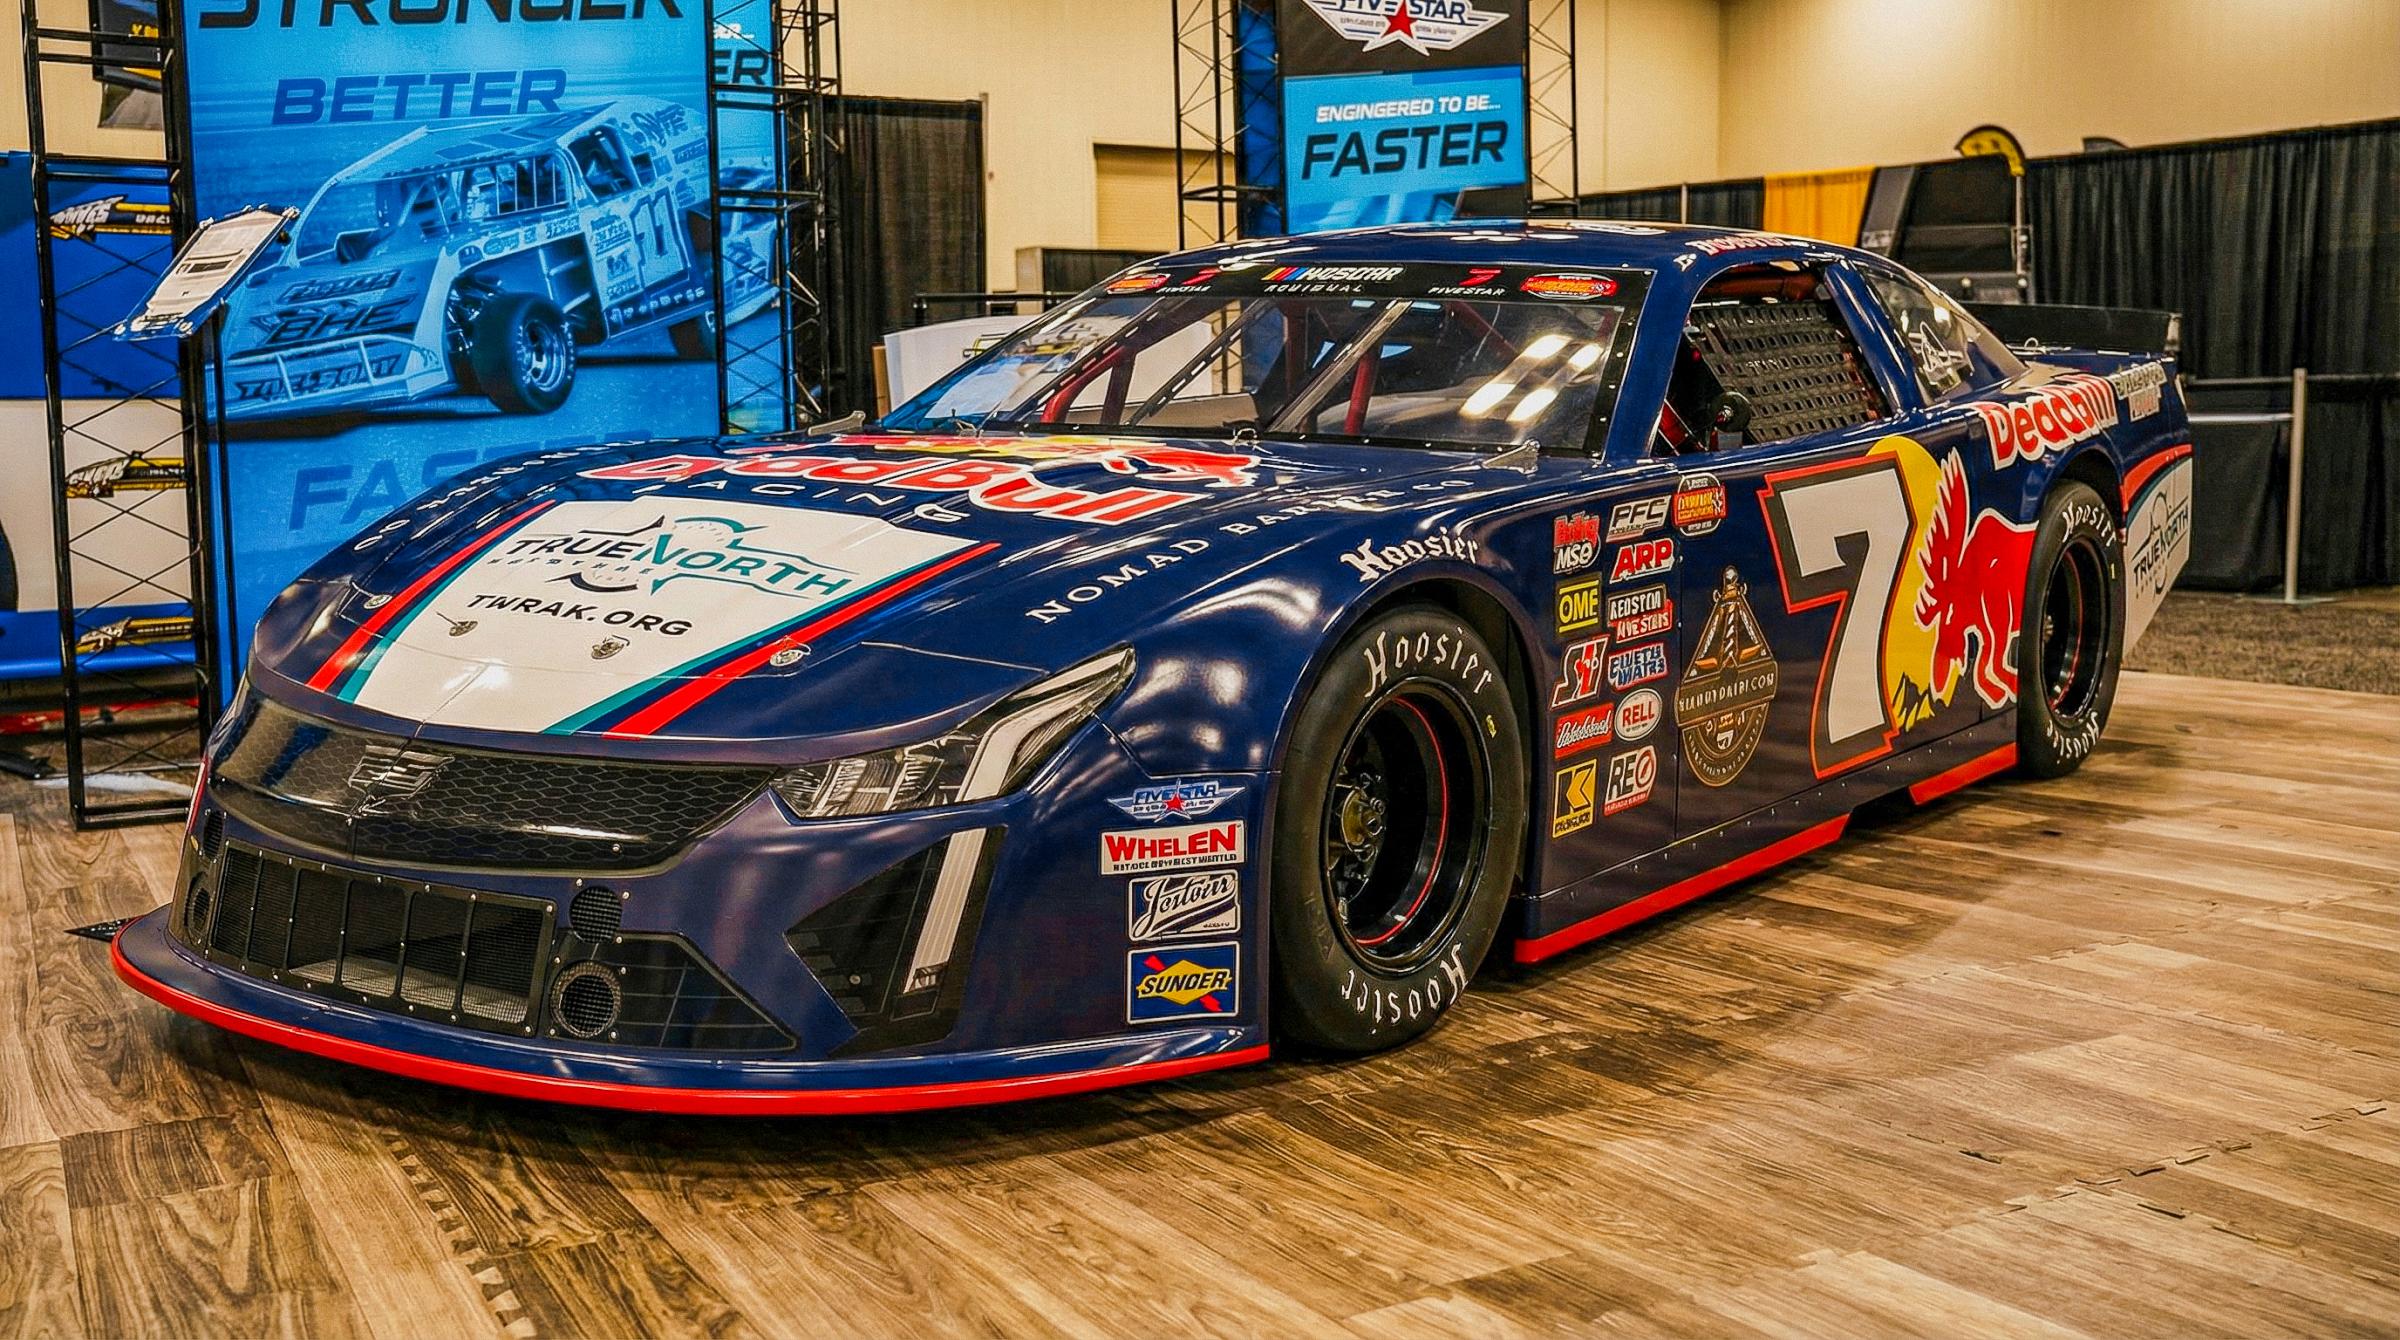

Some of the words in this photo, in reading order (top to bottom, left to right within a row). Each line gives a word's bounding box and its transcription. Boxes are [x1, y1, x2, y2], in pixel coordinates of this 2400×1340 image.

[272, 69, 567, 125] BETTER
[1439, 96, 1462, 114] TO
[1301, 120, 1509, 180] FASTER
[1025, 538, 1211, 625] NOMAD
[1339, 526, 1479, 583] Hoosier
[1615, 538, 1674, 578] ARP
[1761, 455, 1914, 772] 7
[1363, 626, 1493, 698] Hoosier
[1104, 823, 1237, 862] WHELEN
